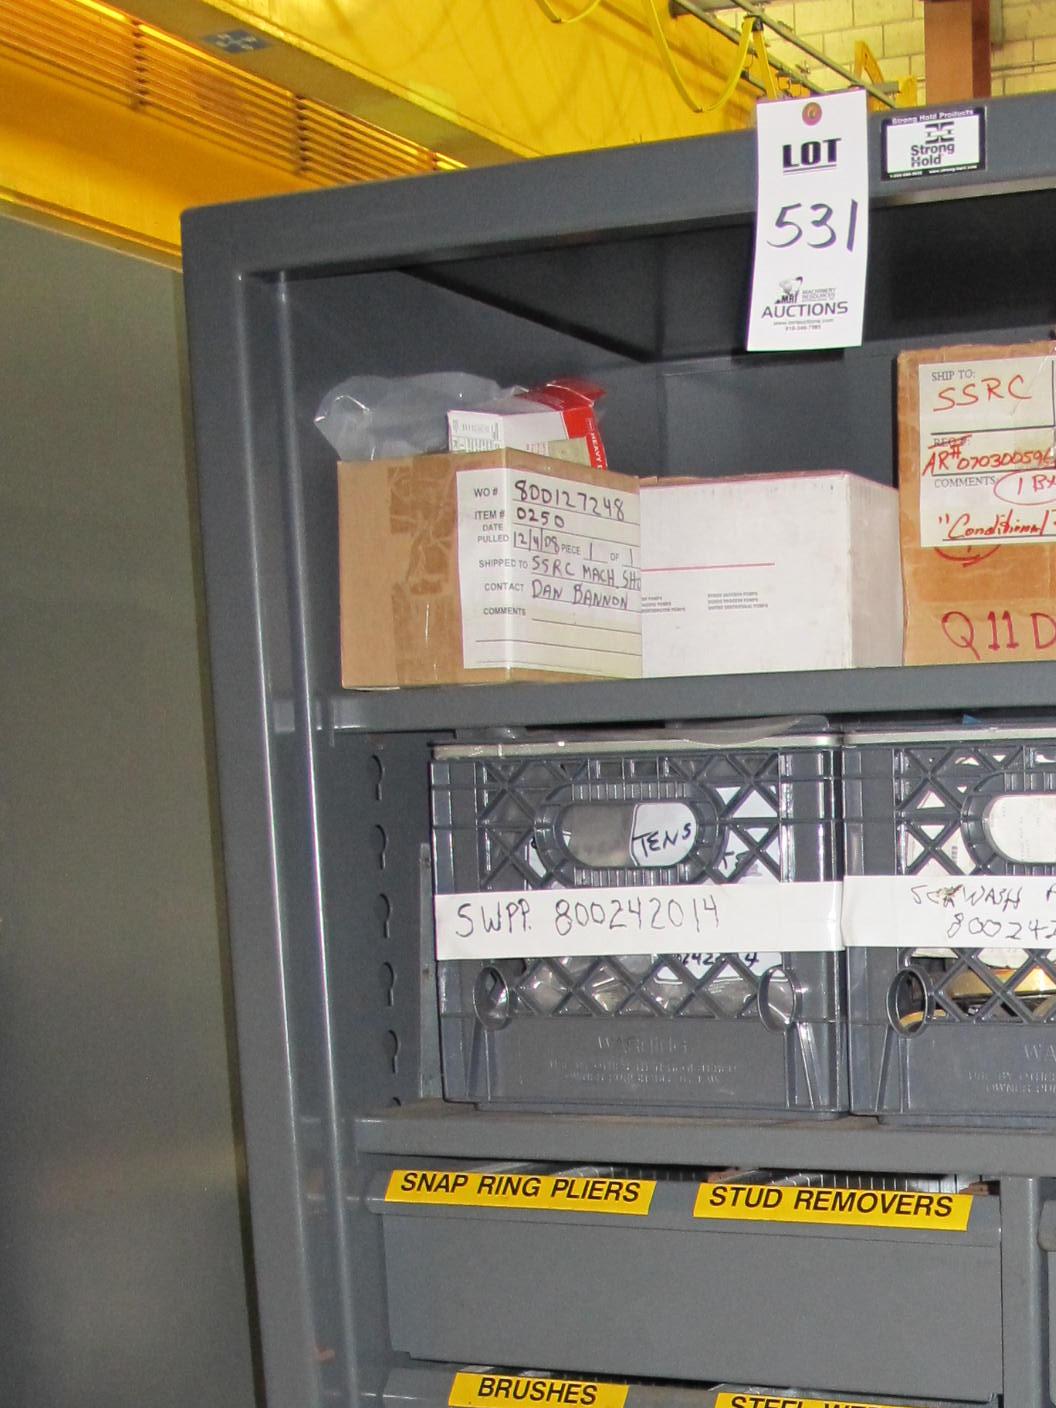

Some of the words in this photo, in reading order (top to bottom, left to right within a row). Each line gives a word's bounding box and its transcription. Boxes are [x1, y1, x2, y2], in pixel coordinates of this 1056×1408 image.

[782, 138, 841, 169] LOT
[911, 143, 955, 157] Strong
[911, 155, 941, 168] Hold
[766, 199, 858, 252] 531
[761, 301, 848, 319] AUCTIONS
[931, 371, 956, 382] SHIP
[958, 370, 976, 380] TO:
[933, 374, 1032, 412] SSRC
[473, 489, 491, 497] WO
[492, 488, 498, 496] #
[515, 479, 625, 522] 800127248
[475, 511, 498, 520] ITEM
[516, 507, 565, 528] 0250
[482, 523, 503, 532] DATE
[477, 534, 510, 543] PULLED
[561, 544, 581, 556] PIECE
[610, 552, 621, 561] OF
[479, 560, 517, 569] SHIPPED
[518, 560, 529, 569] TO
[532, 556, 575, 577] SSRC
[484, 582, 524, 592] CONTACT
[532, 579, 563, 600] DAN
[573, 583, 628, 611] BANNON
[483, 607, 526, 617] COMMENTS
[632, 822, 692, 858] TENS
[555, 894, 719, 936] 800242014
[400, 1171, 468, 1195] SNAP
[476, 1175, 542, 1199] RING
[551, 1178, 641, 1203] PLIERS
[708, 1185, 783, 1209] STUD
[793, 1189, 954, 1219] REMOVERS
[477, 1377, 598, 1407] BRUSHES
